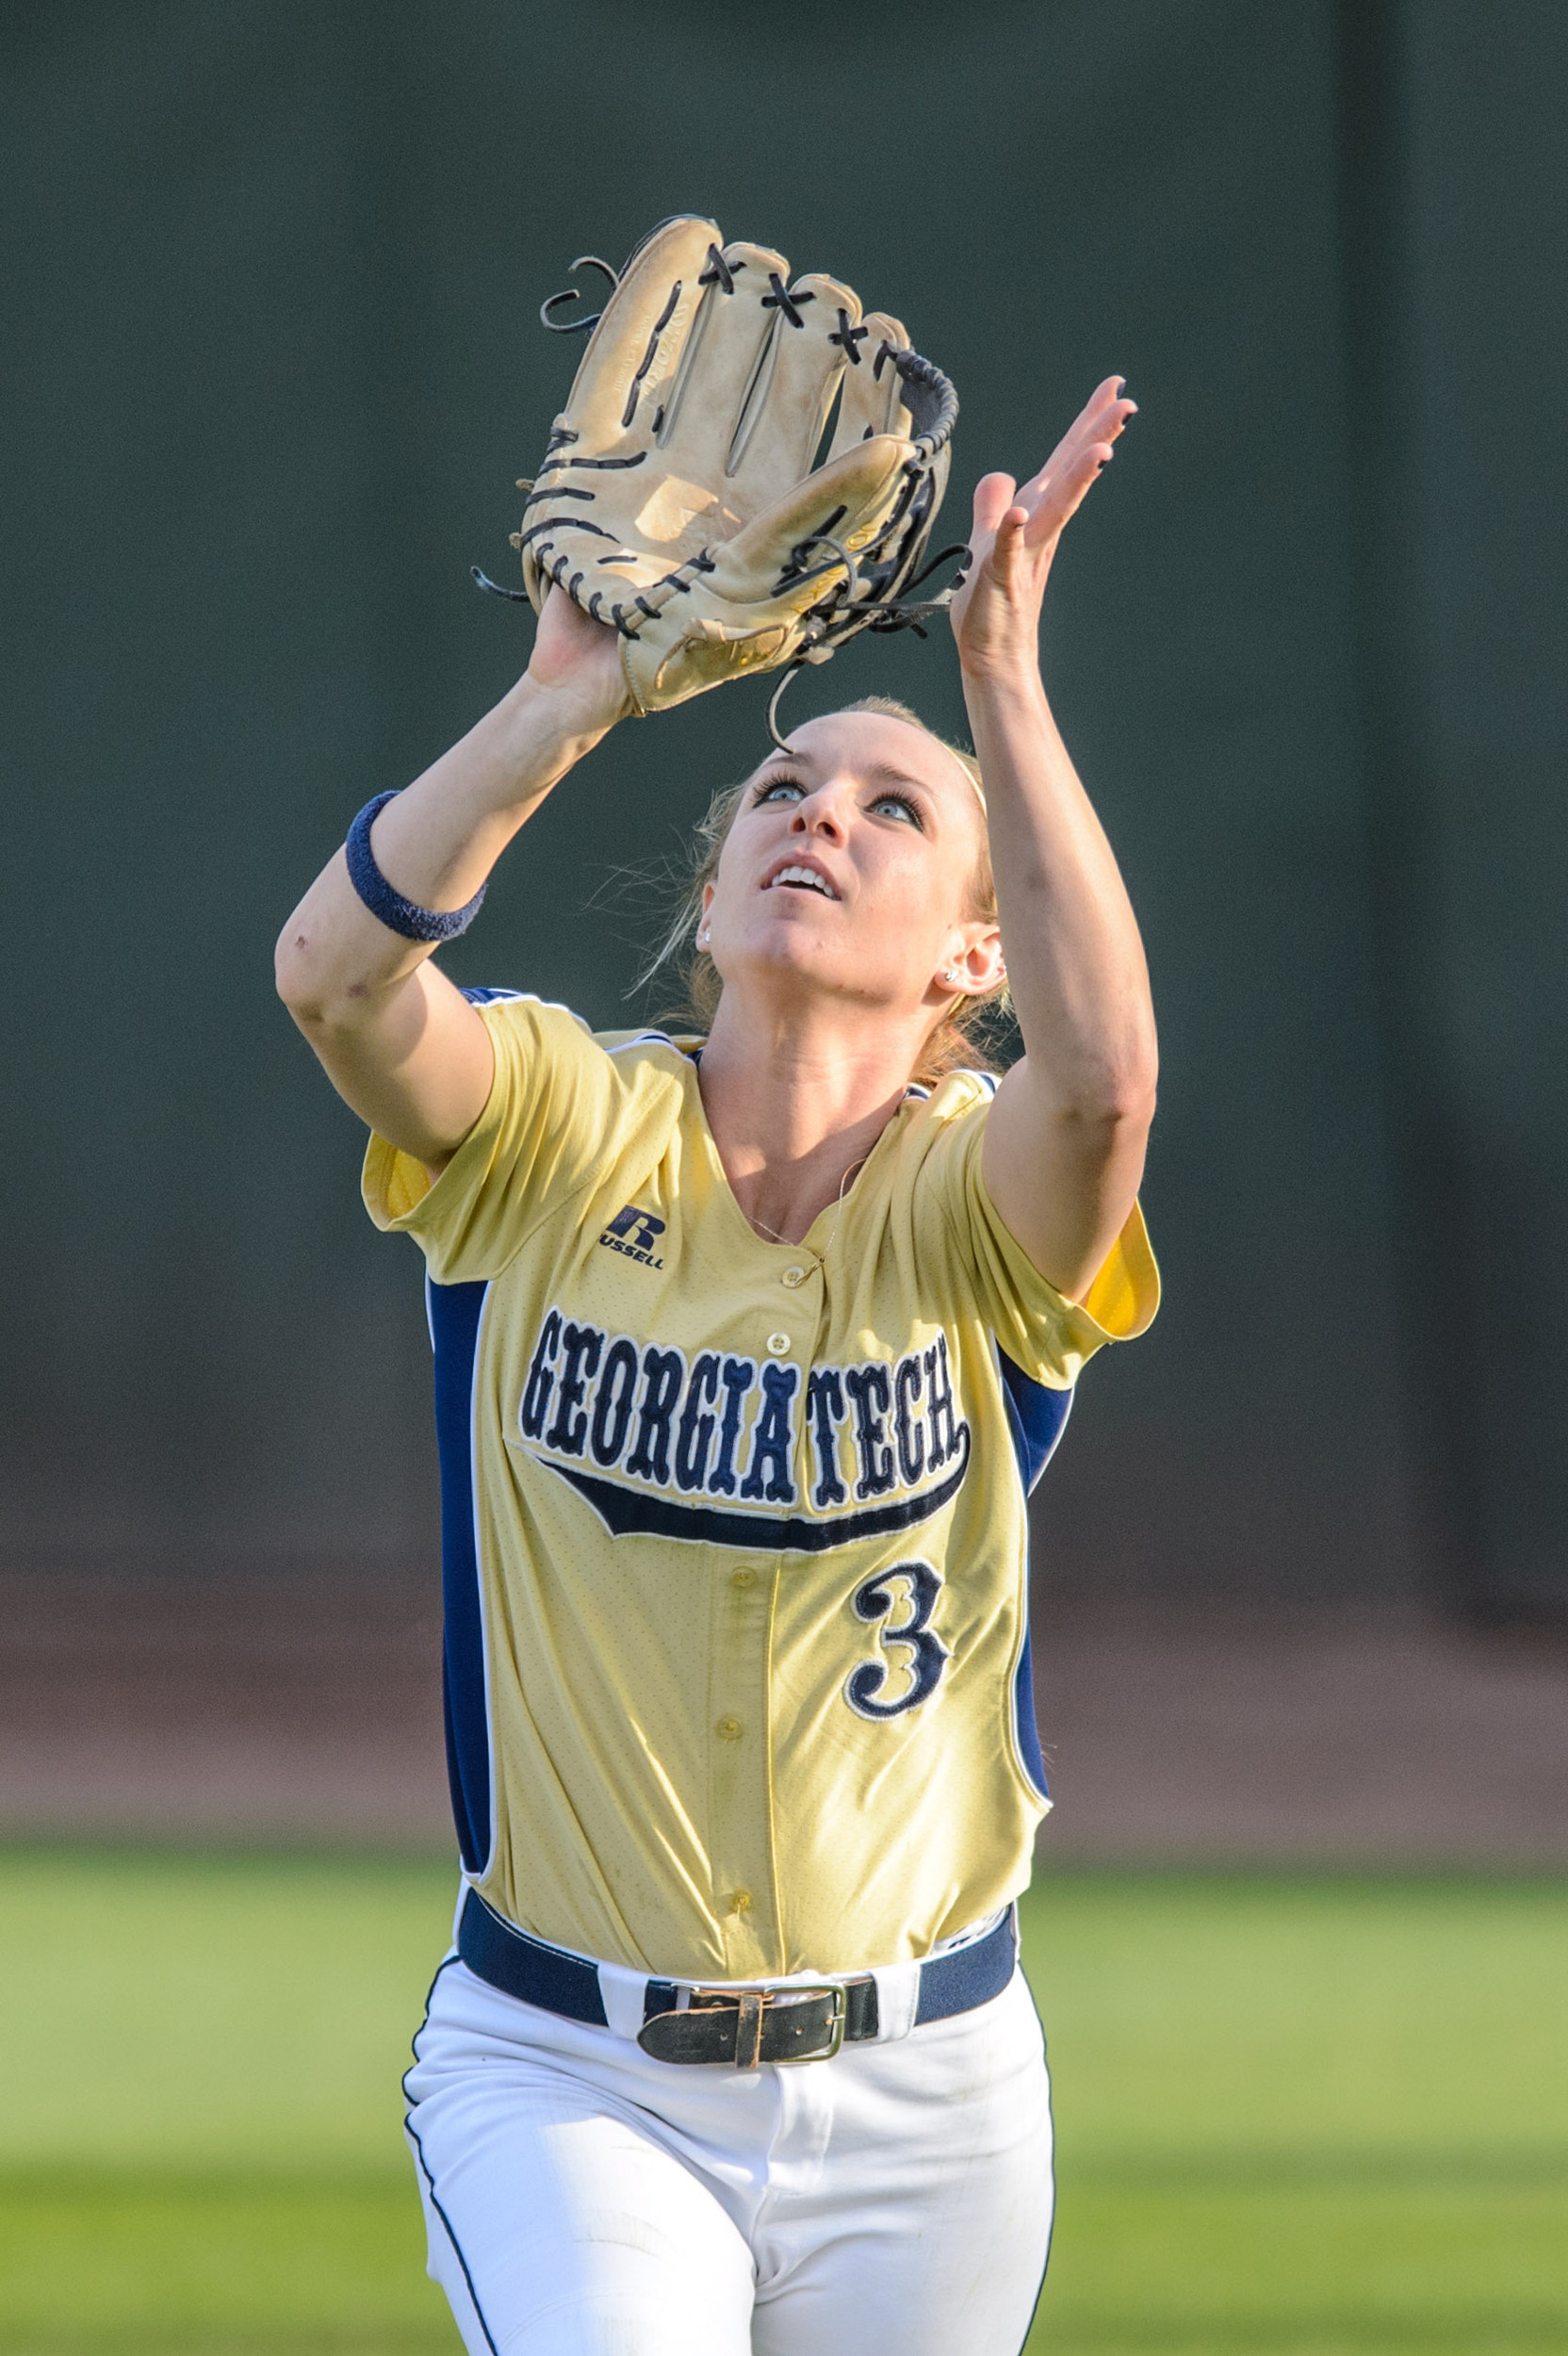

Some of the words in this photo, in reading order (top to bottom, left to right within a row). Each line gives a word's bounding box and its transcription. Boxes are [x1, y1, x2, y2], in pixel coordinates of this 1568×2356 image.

[598, 1233, 664, 1270] USSELL
[518, 1304, 801, 1505] GEORGIA
[802, 1326, 972, 1510] TECH
[842, 1557, 955, 1722] 3
